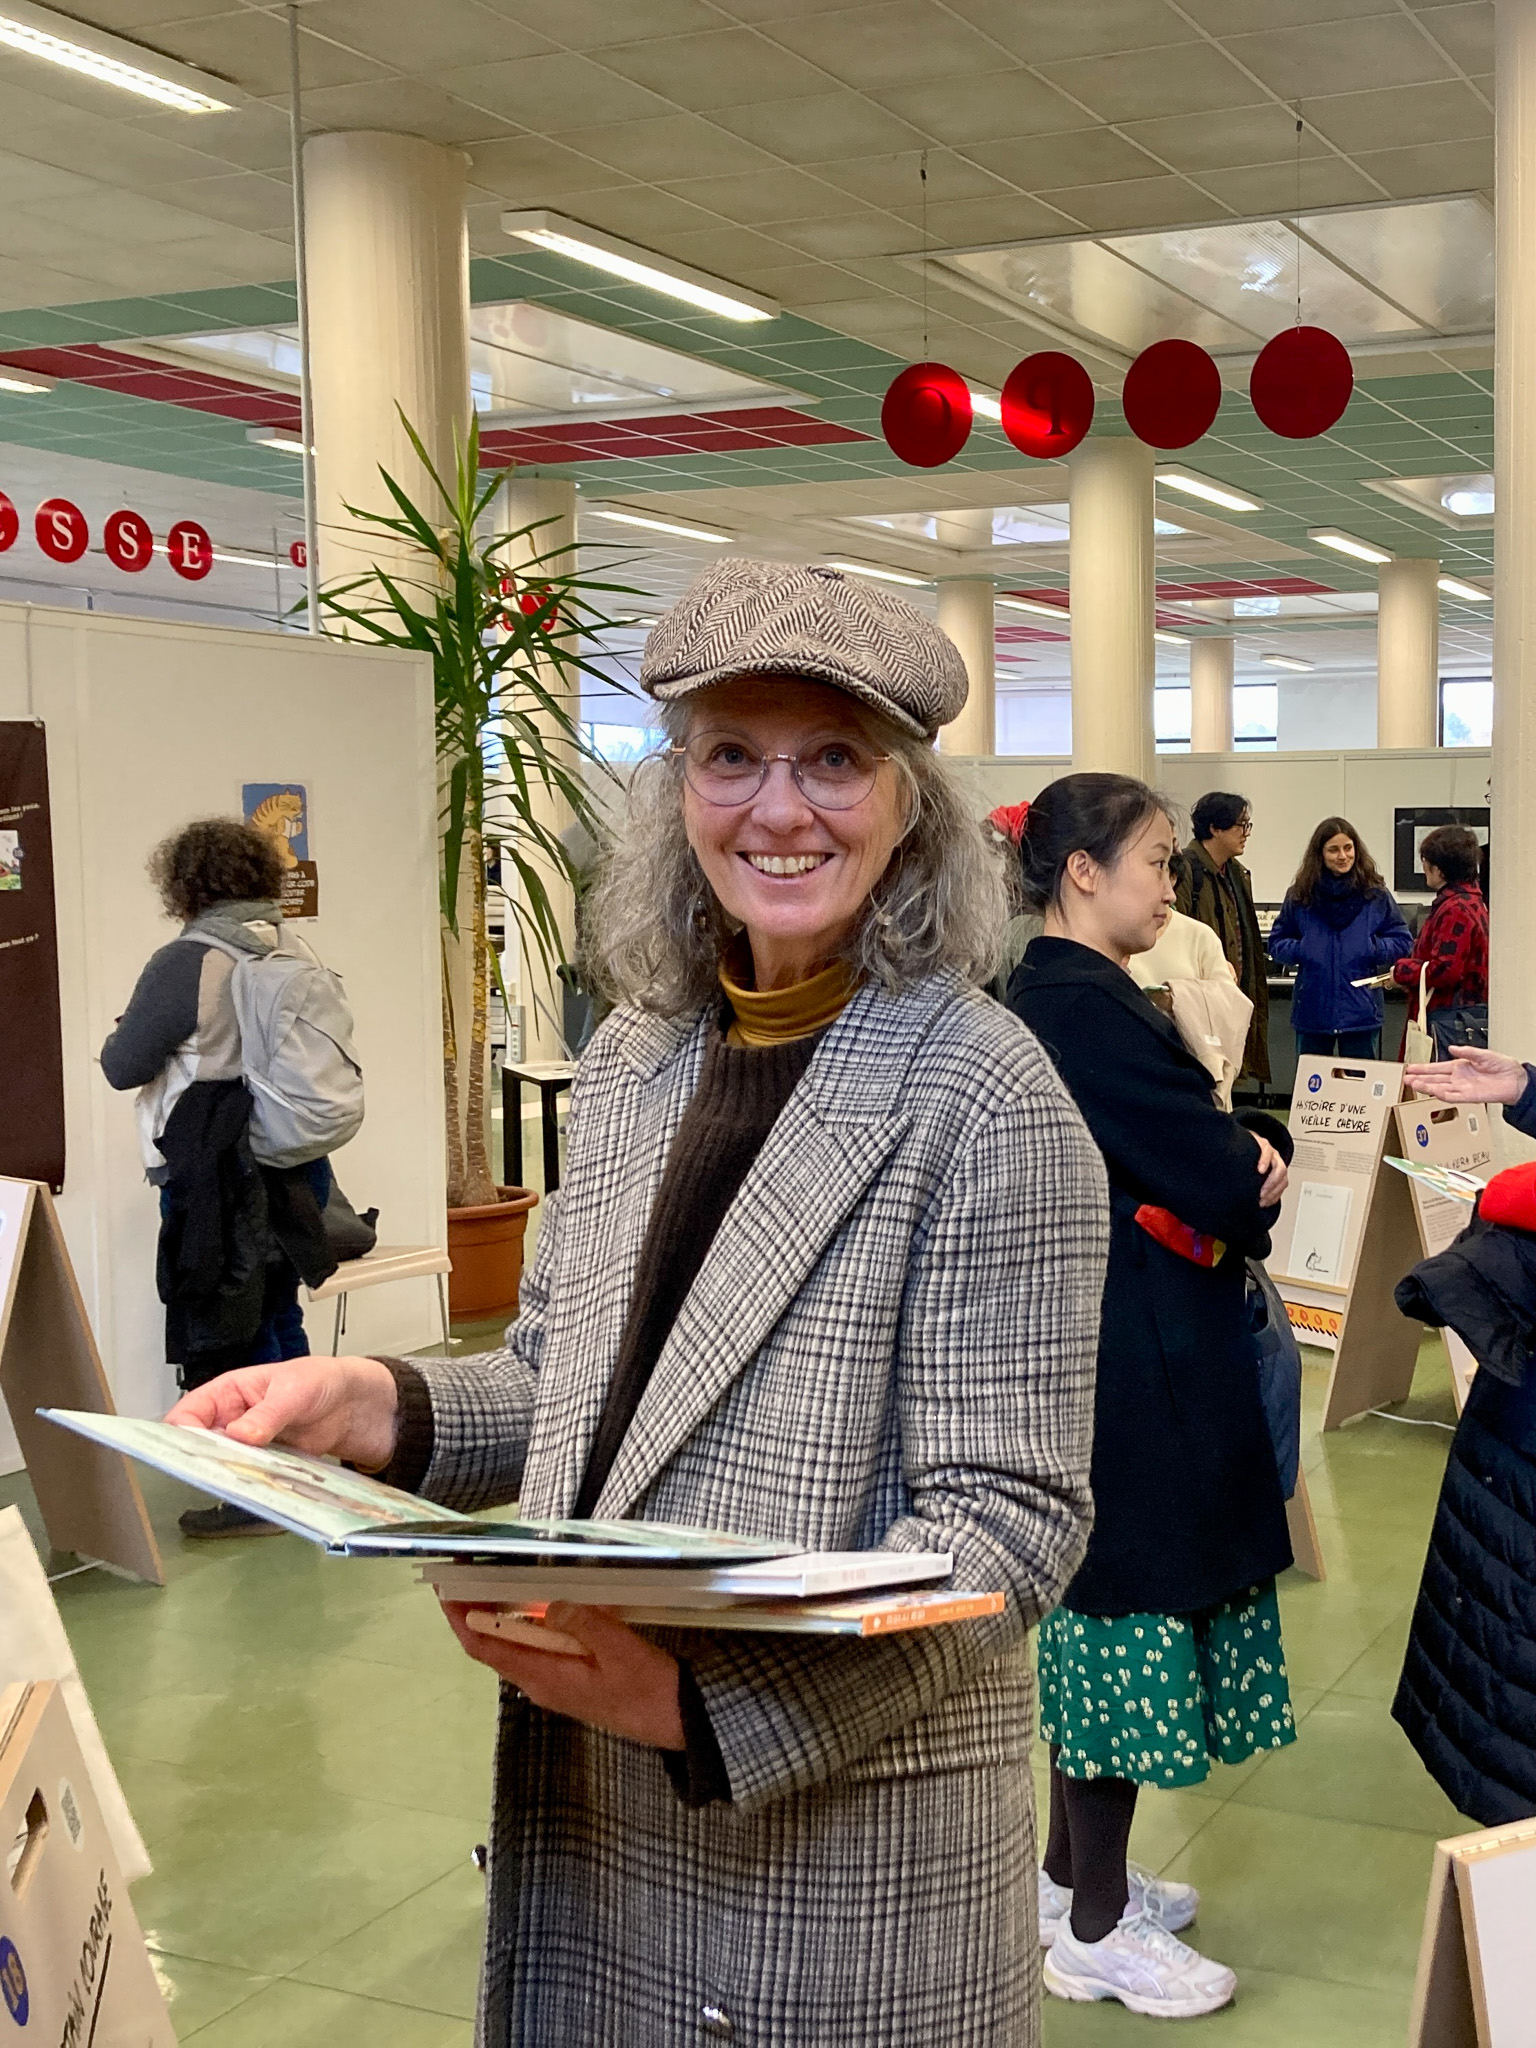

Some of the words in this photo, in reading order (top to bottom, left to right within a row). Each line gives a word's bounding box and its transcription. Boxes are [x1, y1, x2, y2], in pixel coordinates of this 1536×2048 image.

[1309, 1077, 1320, 1089] 21
[1340, 1103, 1367, 1115] D'UNE
[1301, 1114, 1331, 1127] VIEILLE
[1, 1952, 24, 2012] 18
